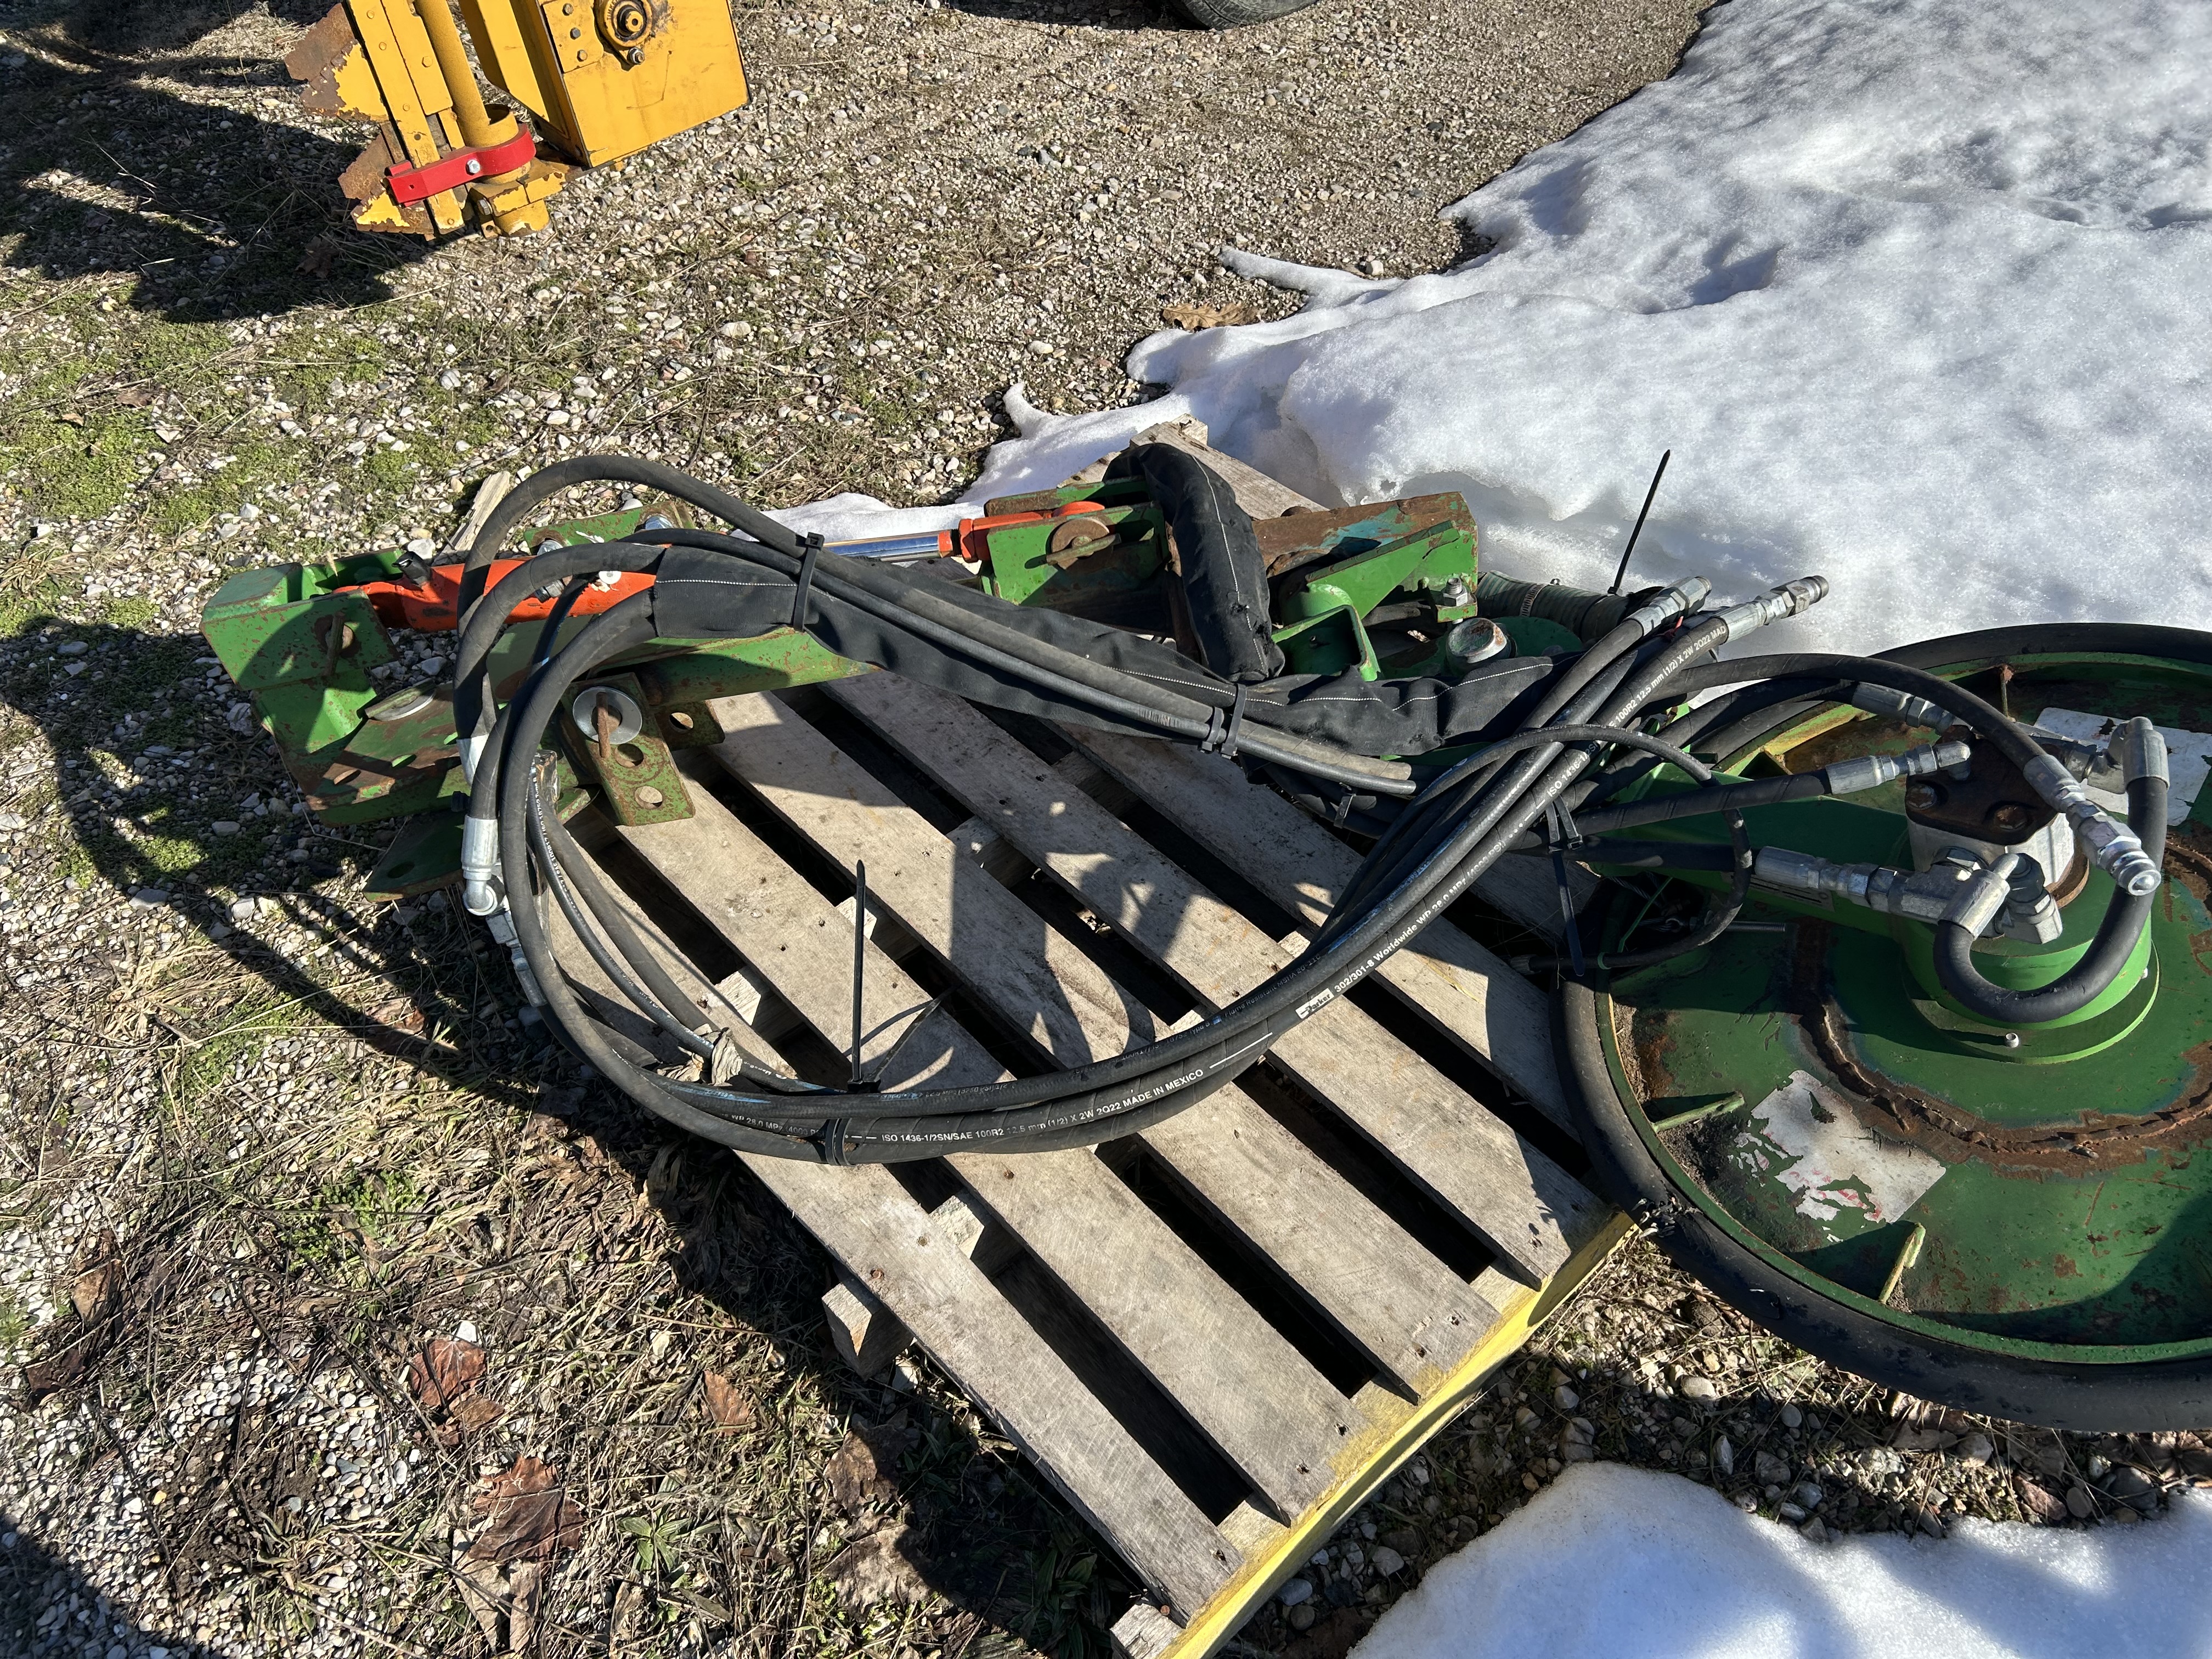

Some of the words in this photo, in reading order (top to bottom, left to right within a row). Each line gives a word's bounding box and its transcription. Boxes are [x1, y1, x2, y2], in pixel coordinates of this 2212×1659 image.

[1334, 960, 1375, 992] 302/301-8
[1373, 924, 1418, 961] Worldwide
[1416, 910, 1431, 924] WP
[1432, 894, 1449, 912] 28.0
[1547, 780, 1562, 797] ISO
[1615, 697, 1638, 723] 100R2
[1637, 686, 1652, 702] 12.5
[1651, 674, 1665, 688] mm
[1663, 659, 1679, 677] (1/2)
[1677, 654, 1684, 663] X
[1683, 646, 1694, 659] 2W
[1694, 634, 1711, 651] 2Q22
[1709, 625, 1726, 640] MAD
[746, 1117, 764, 1127] 28.0
[881, 1134, 898, 1142] ISO
[900, 1131, 974, 1142] 1436-1/2SN/SAE
[975, 1127, 1005, 1138] 100R2
[1007, 1125, 1026, 1135] 12.5
[1028, 1122, 1047, 1131] mm
[1048, 1116, 1069, 1128] (1/2)
[1080, 1109, 1094, 1121] 2W
[1096, 1102, 1122, 1116] 2Q22
[1122, 1090, 1153, 1107] MADE
[1153, 1086, 1165, 1097] IN
[1165, 1069, 1204, 1091] MEXICO
